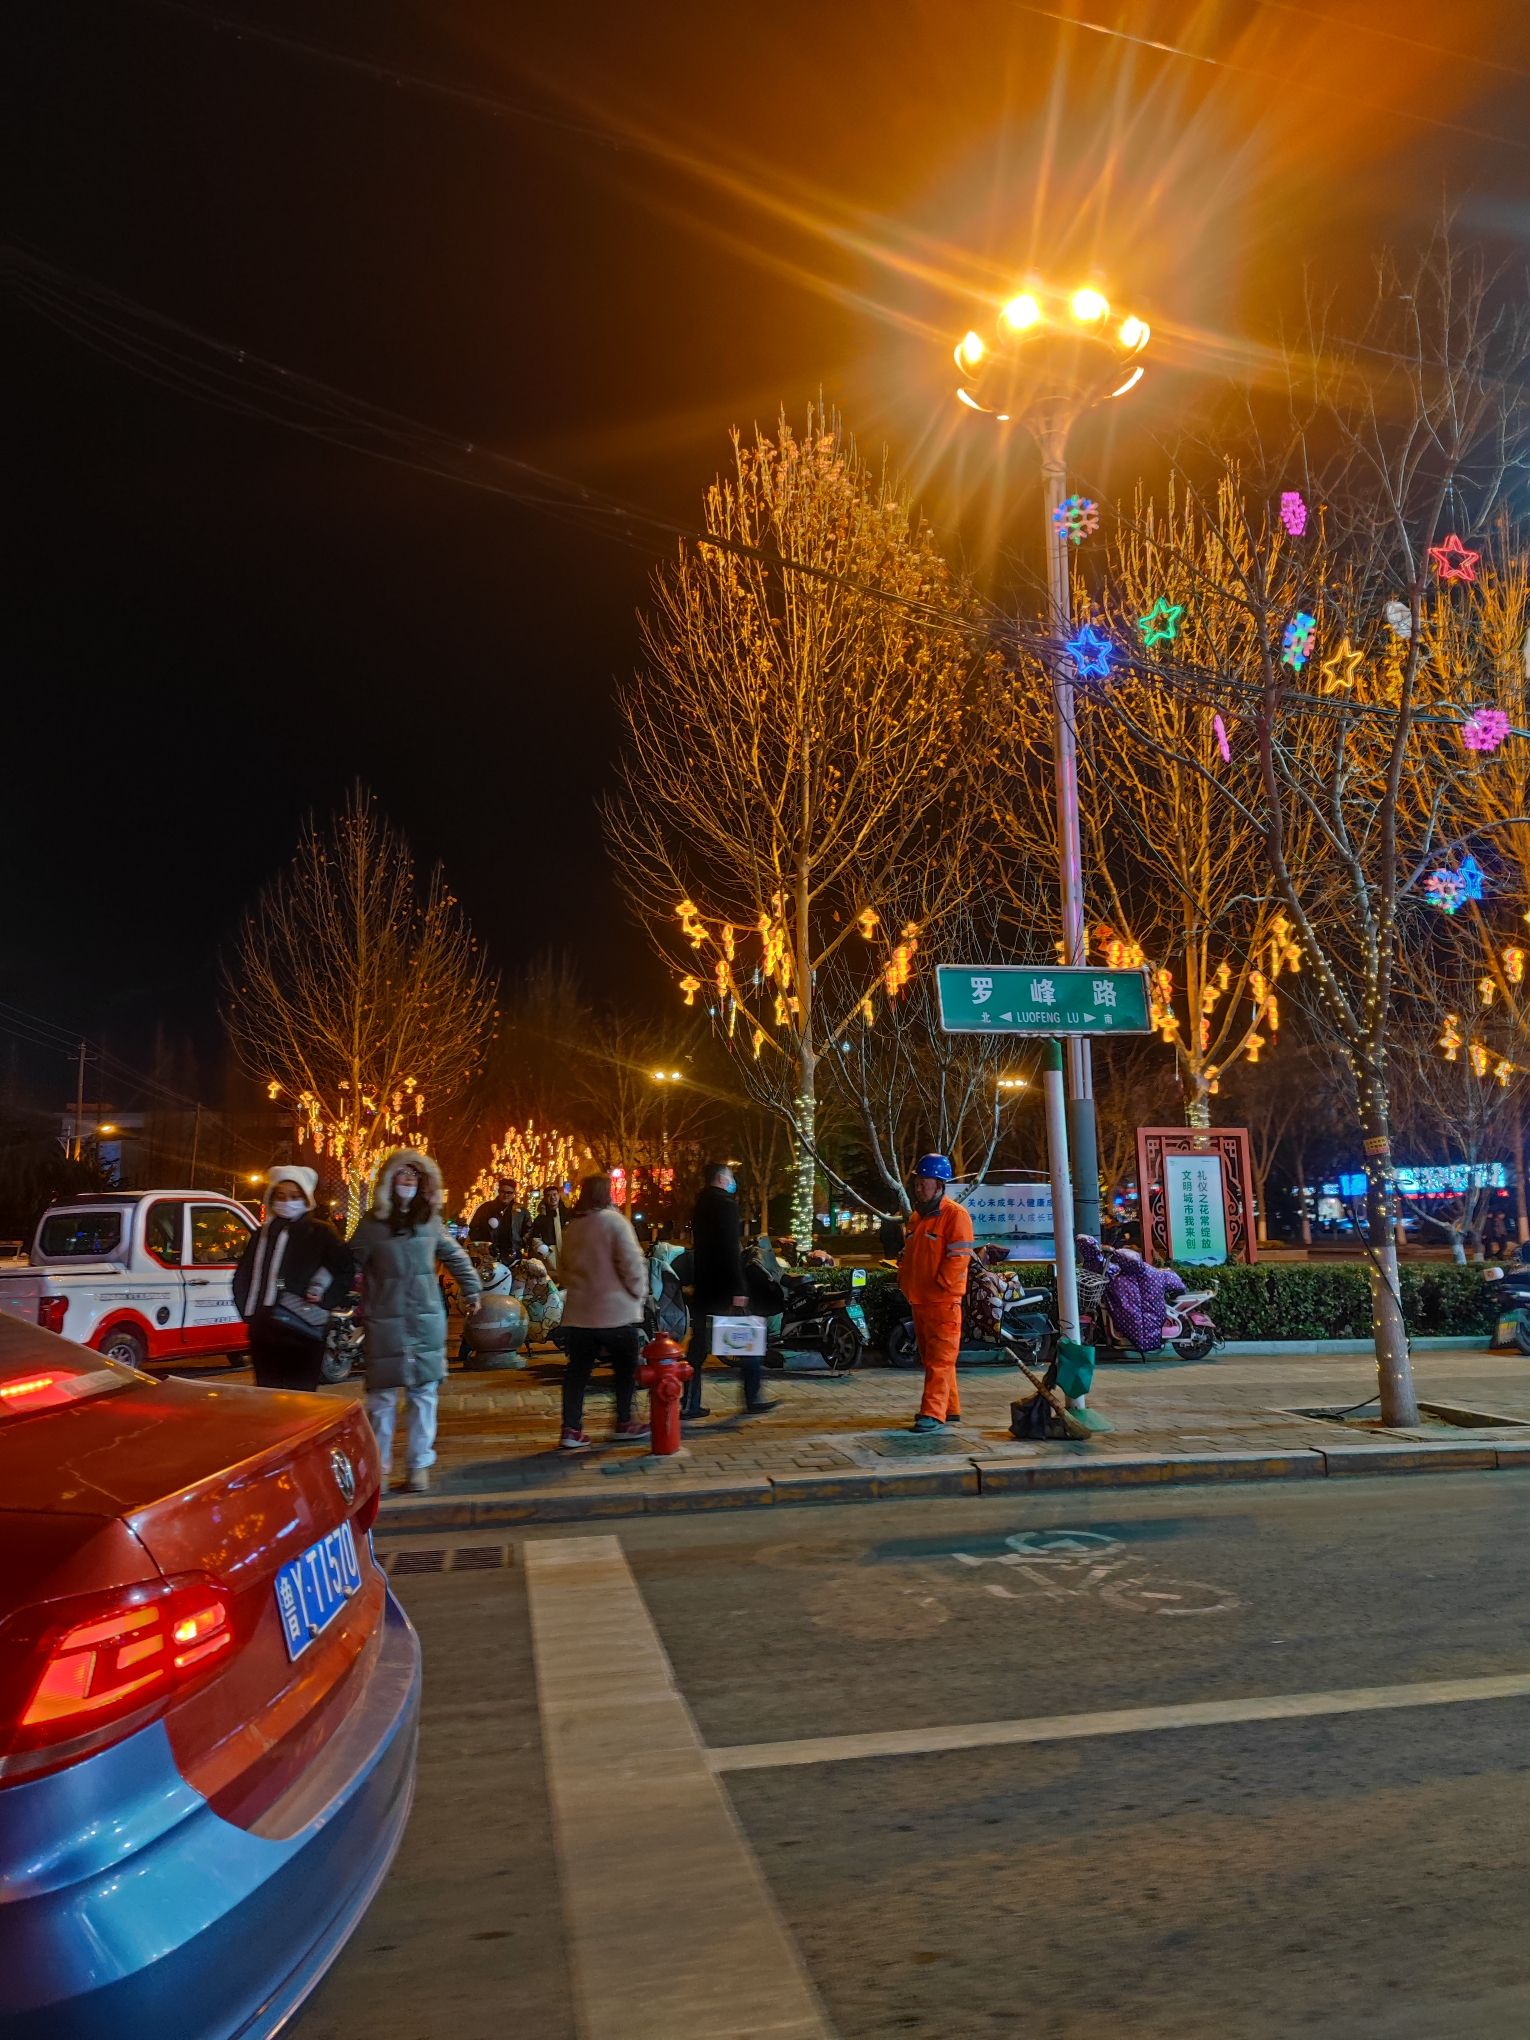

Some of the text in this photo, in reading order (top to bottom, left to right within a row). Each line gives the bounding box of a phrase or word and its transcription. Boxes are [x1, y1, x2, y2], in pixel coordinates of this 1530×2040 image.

[970, 977, 1117, 1007] 罗峰路
[982, 1012, 991, 1024] 北
[1017, 1012, 1079, 1024] LUOFENG LU
[1104, 1014, 1113, 1025] 南
[1182, 1170, 1196, 1249] 文明城市我来创
[1197, 1170, 1212, 1249] 礼仪之花常绽放
